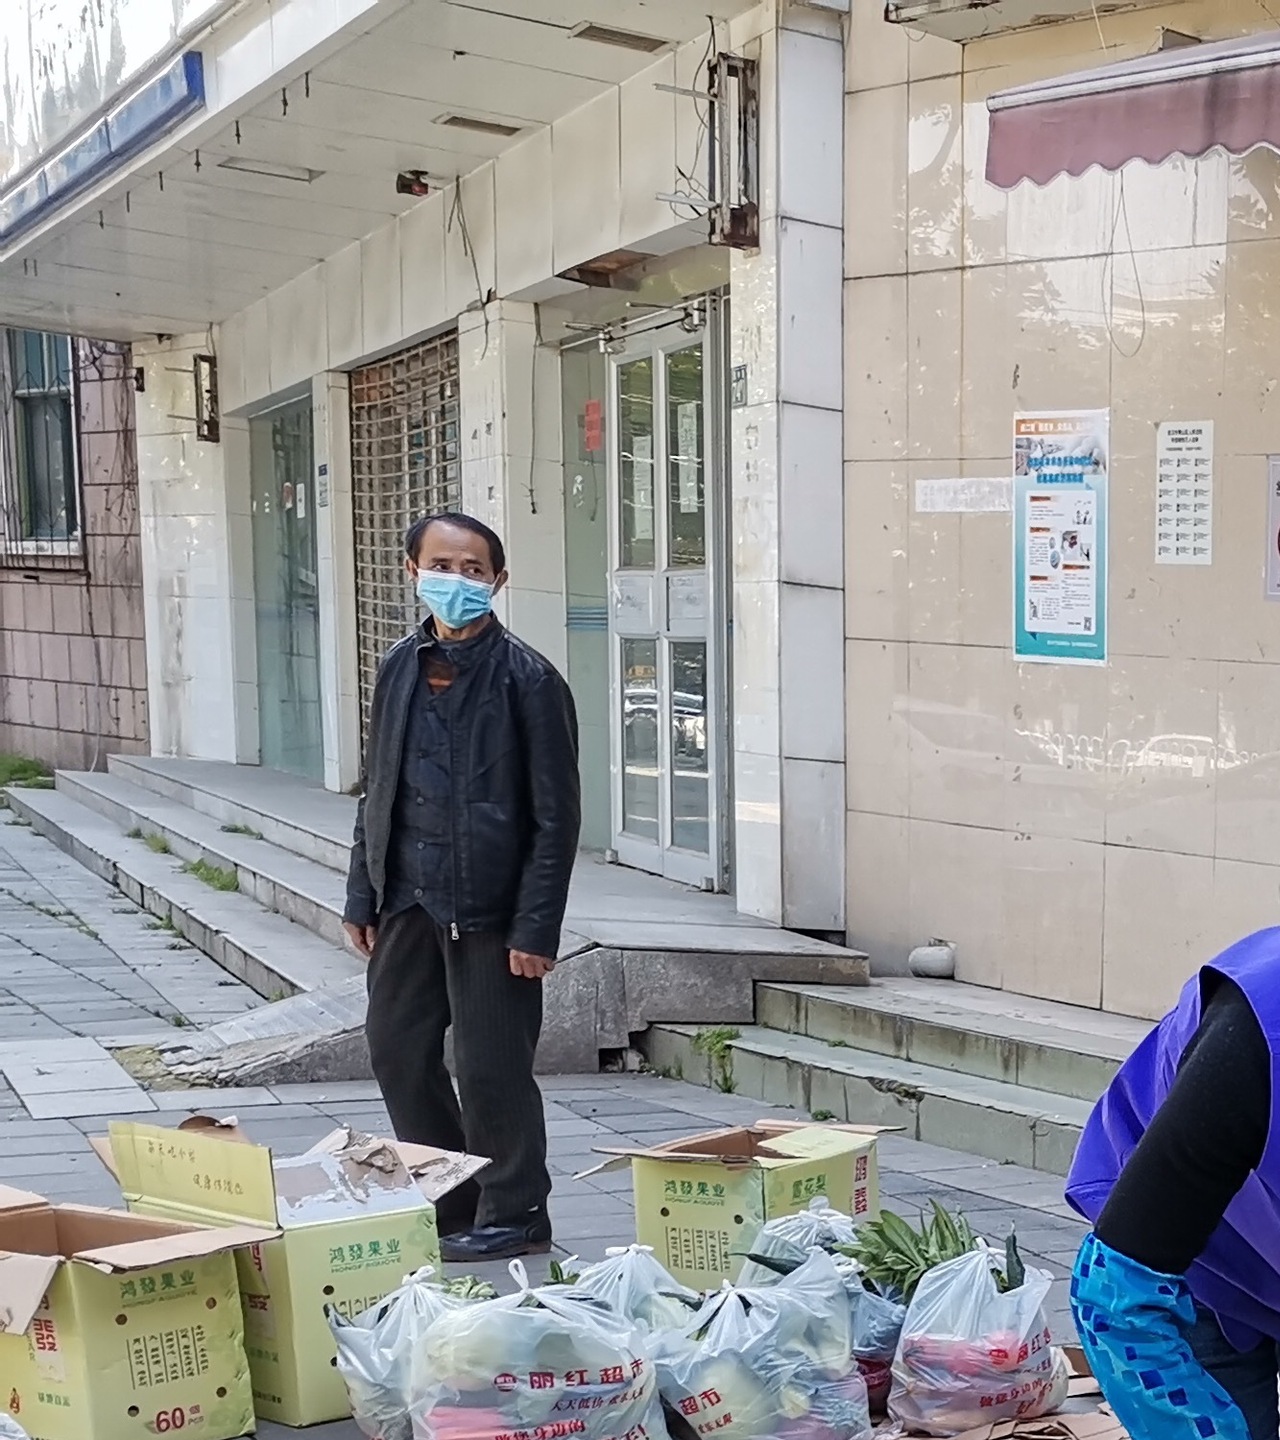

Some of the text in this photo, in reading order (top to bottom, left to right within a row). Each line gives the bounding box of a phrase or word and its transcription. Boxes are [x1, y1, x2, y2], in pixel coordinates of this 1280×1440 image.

[329, 1238, 401, 1264] 鸿發果业
[528, 1358, 643, 1389] 丽红超市
[678, 1387, 722, 1417] 超市
[155, 1407, 186, 1433] 60
